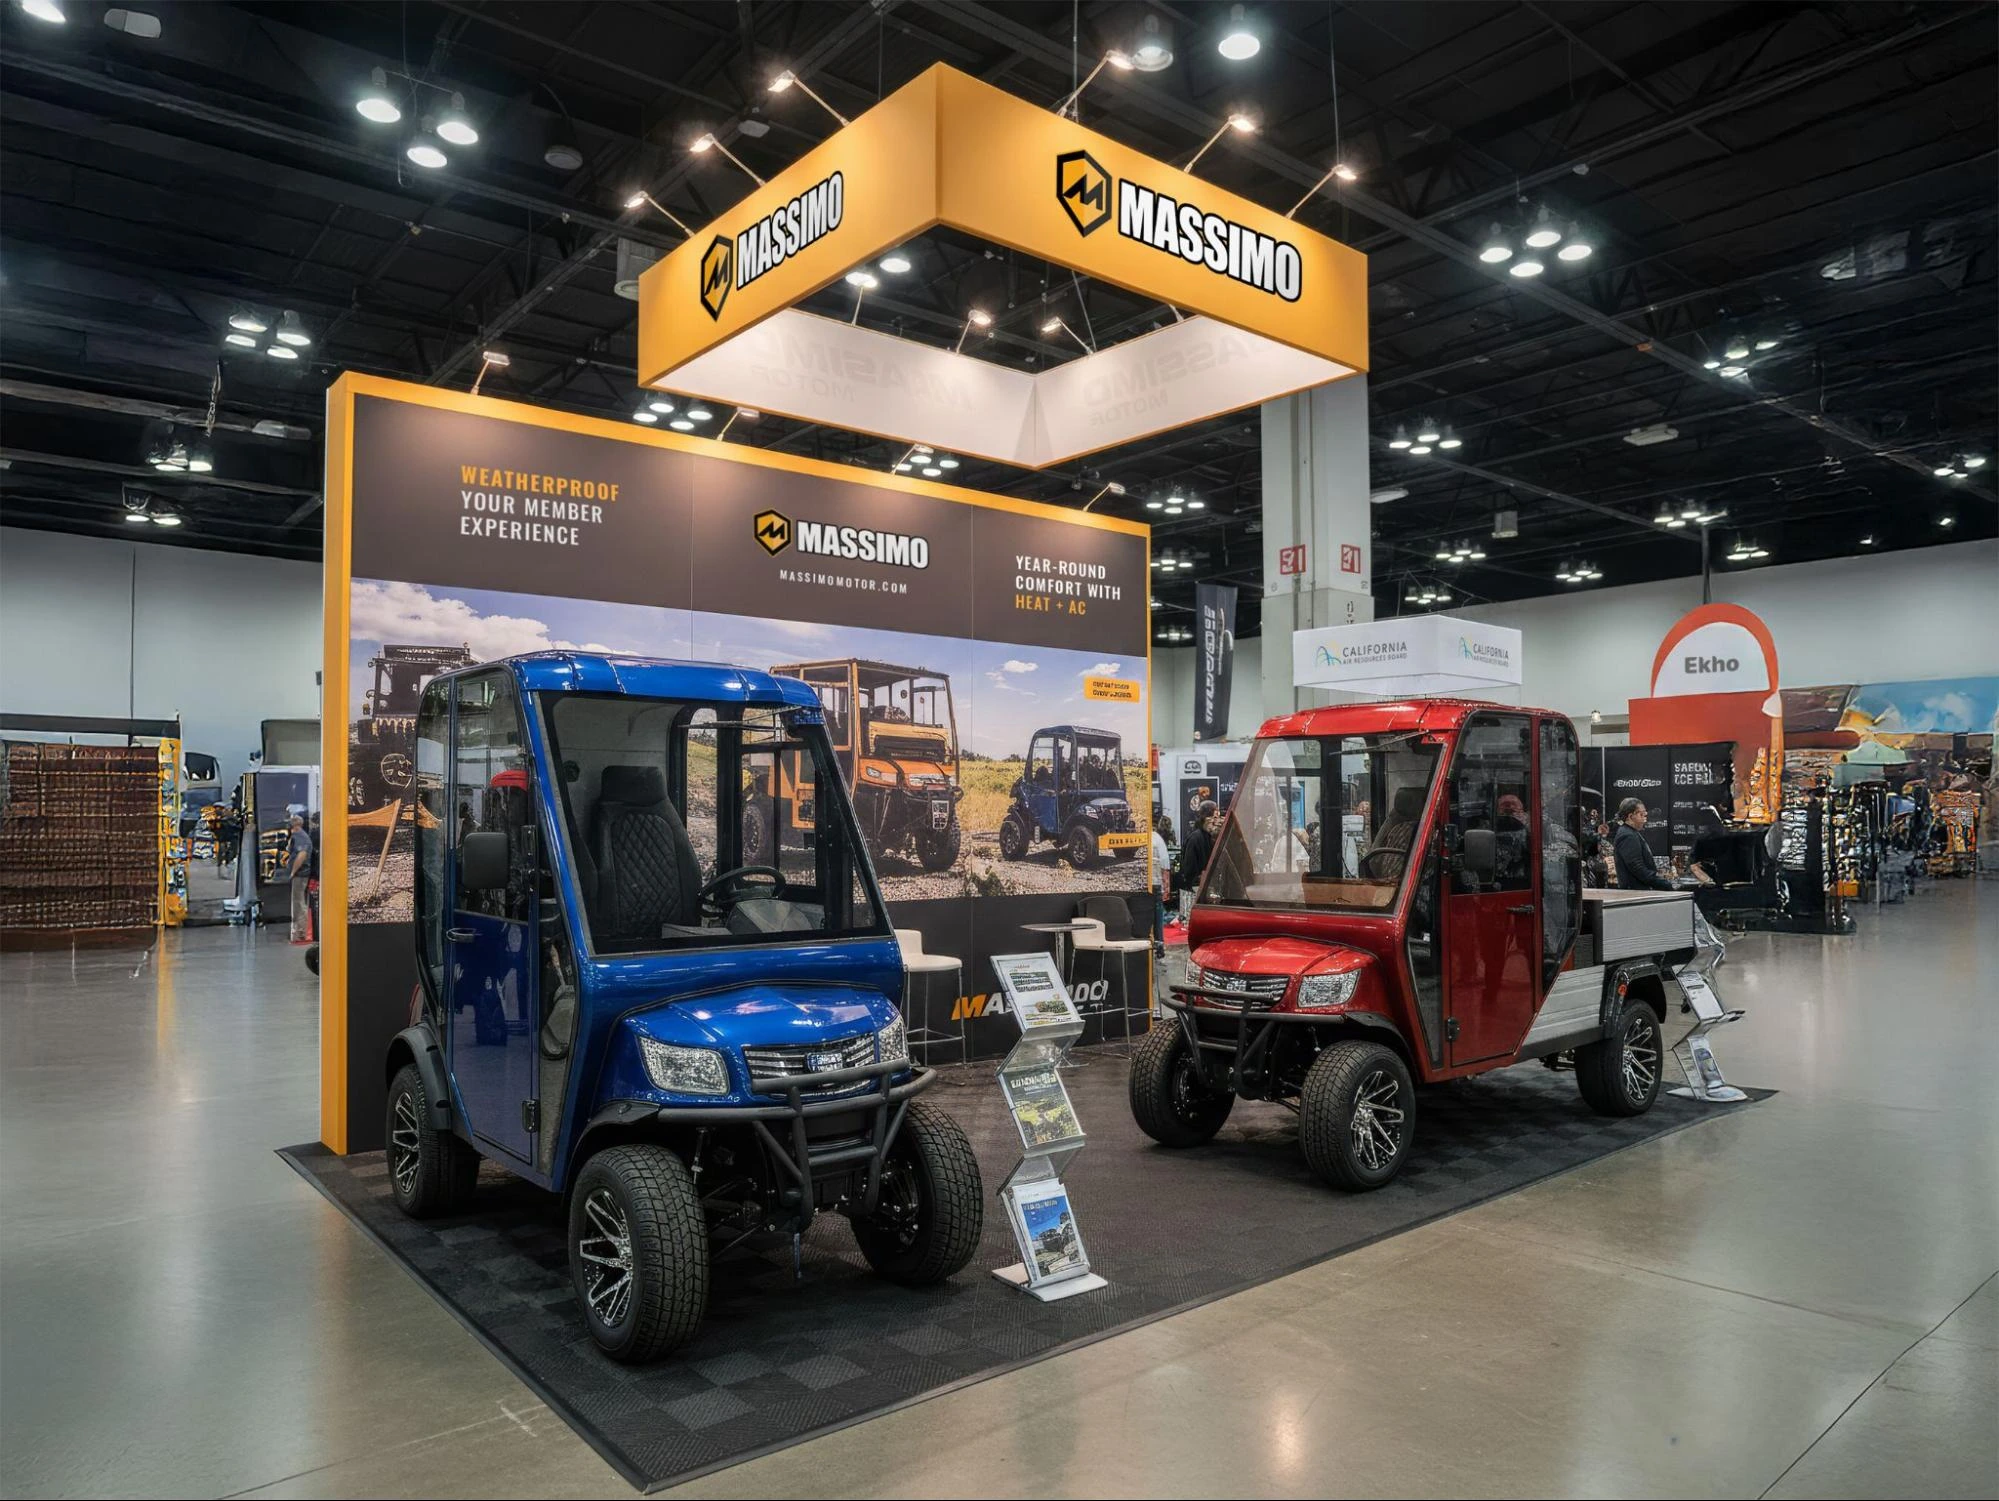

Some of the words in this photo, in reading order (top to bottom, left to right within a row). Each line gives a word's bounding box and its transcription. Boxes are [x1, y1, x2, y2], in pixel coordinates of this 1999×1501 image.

[737, 171, 843, 290] MASSIMO
[1118, 178, 1302, 302] MASSIMO
[461, 465, 619, 501] WEATHERPROOF
[461, 490, 515, 514] YOUR
[524, 498, 602, 523] MEMBER
[460, 516, 579, 545] EXPERIENCE
[796, 520, 929, 569] MASSIMO
[1016, 555, 1106, 579] YEAR-ROUND
[780, 569, 907, 593] MASSIMOMOTOR.COM
[1016, 576, 1082, 596] COMFORT
[1088, 583, 1121, 600] WITH
[1016, 594, 1050, 611] HEAT
[1056, 601, 1064, 609] +
[1069, 600, 1086, 615] AC
[1342, 641, 1408, 658] CALIFORNIA
[1685, 656, 1740, 674] Ekho
